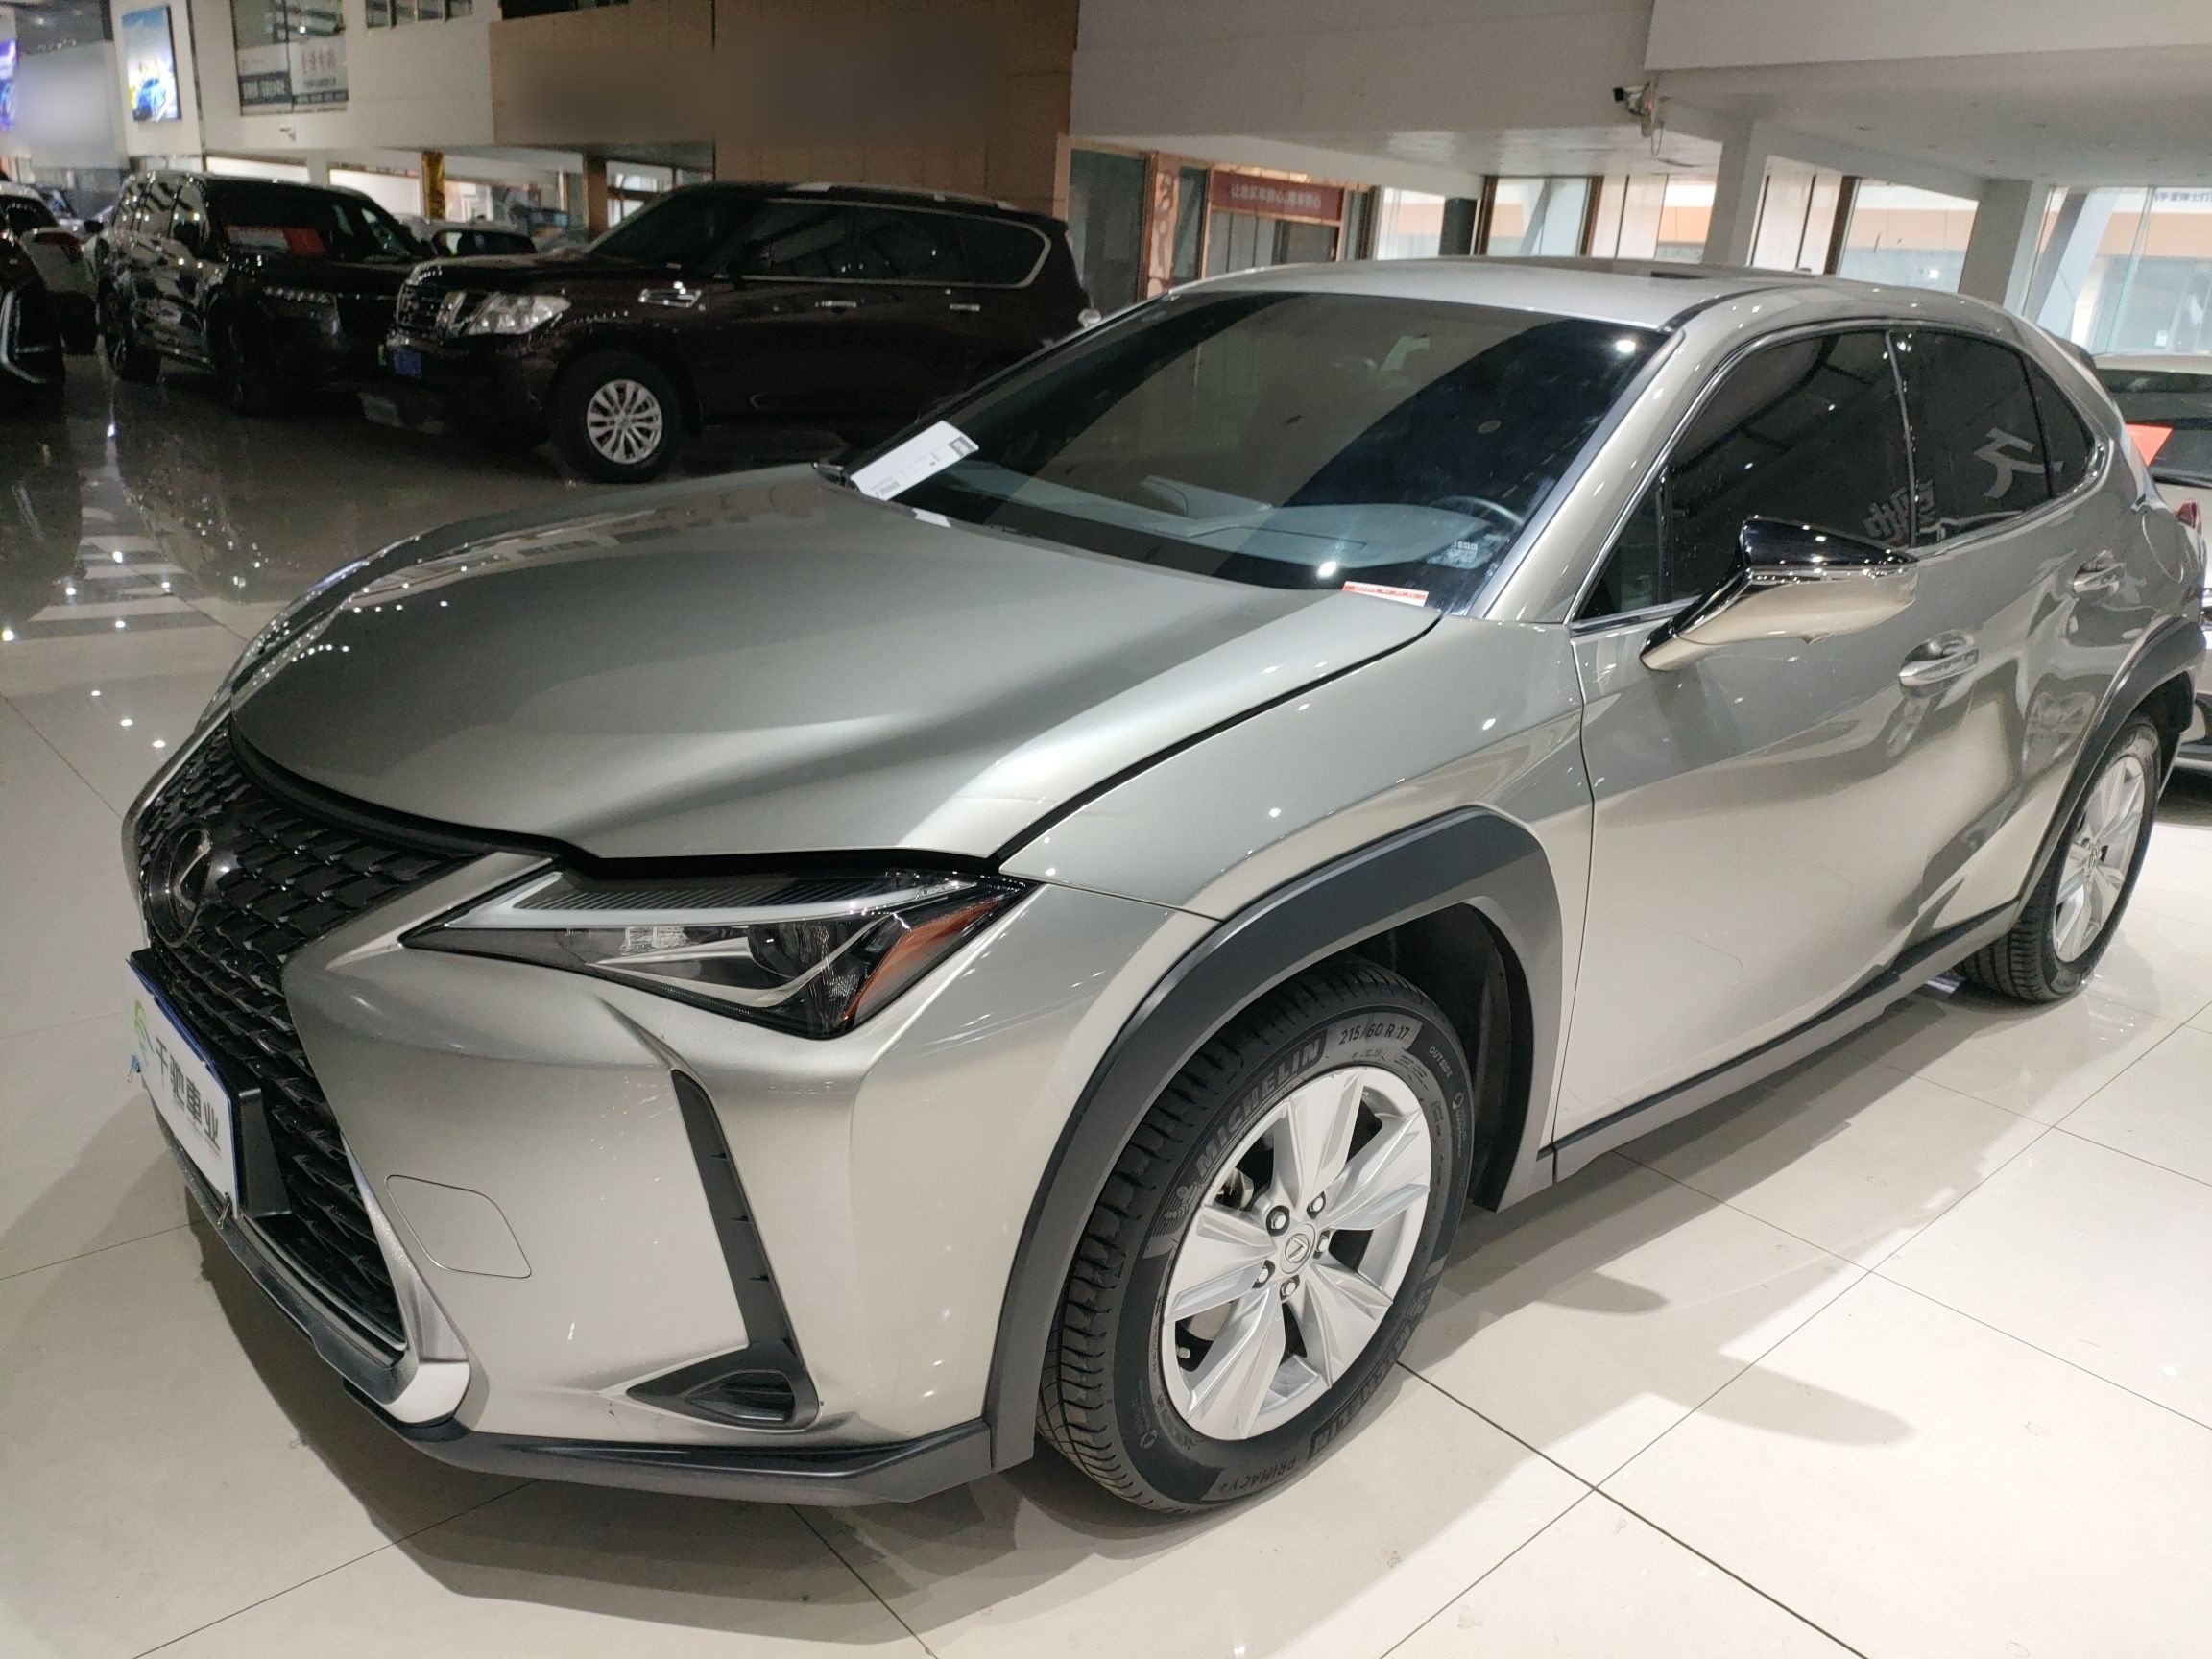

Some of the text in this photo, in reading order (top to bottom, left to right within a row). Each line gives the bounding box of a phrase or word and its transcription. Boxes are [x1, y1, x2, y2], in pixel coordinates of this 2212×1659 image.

[1339, 1023, 1410, 1045] 215/60 R 17
[1429, 1046, 1454, 1079] OUTSIDE
[1195, 1038, 1320, 1179] MICHELIN
[1228, 1455, 1298, 1492] PRIMACY
